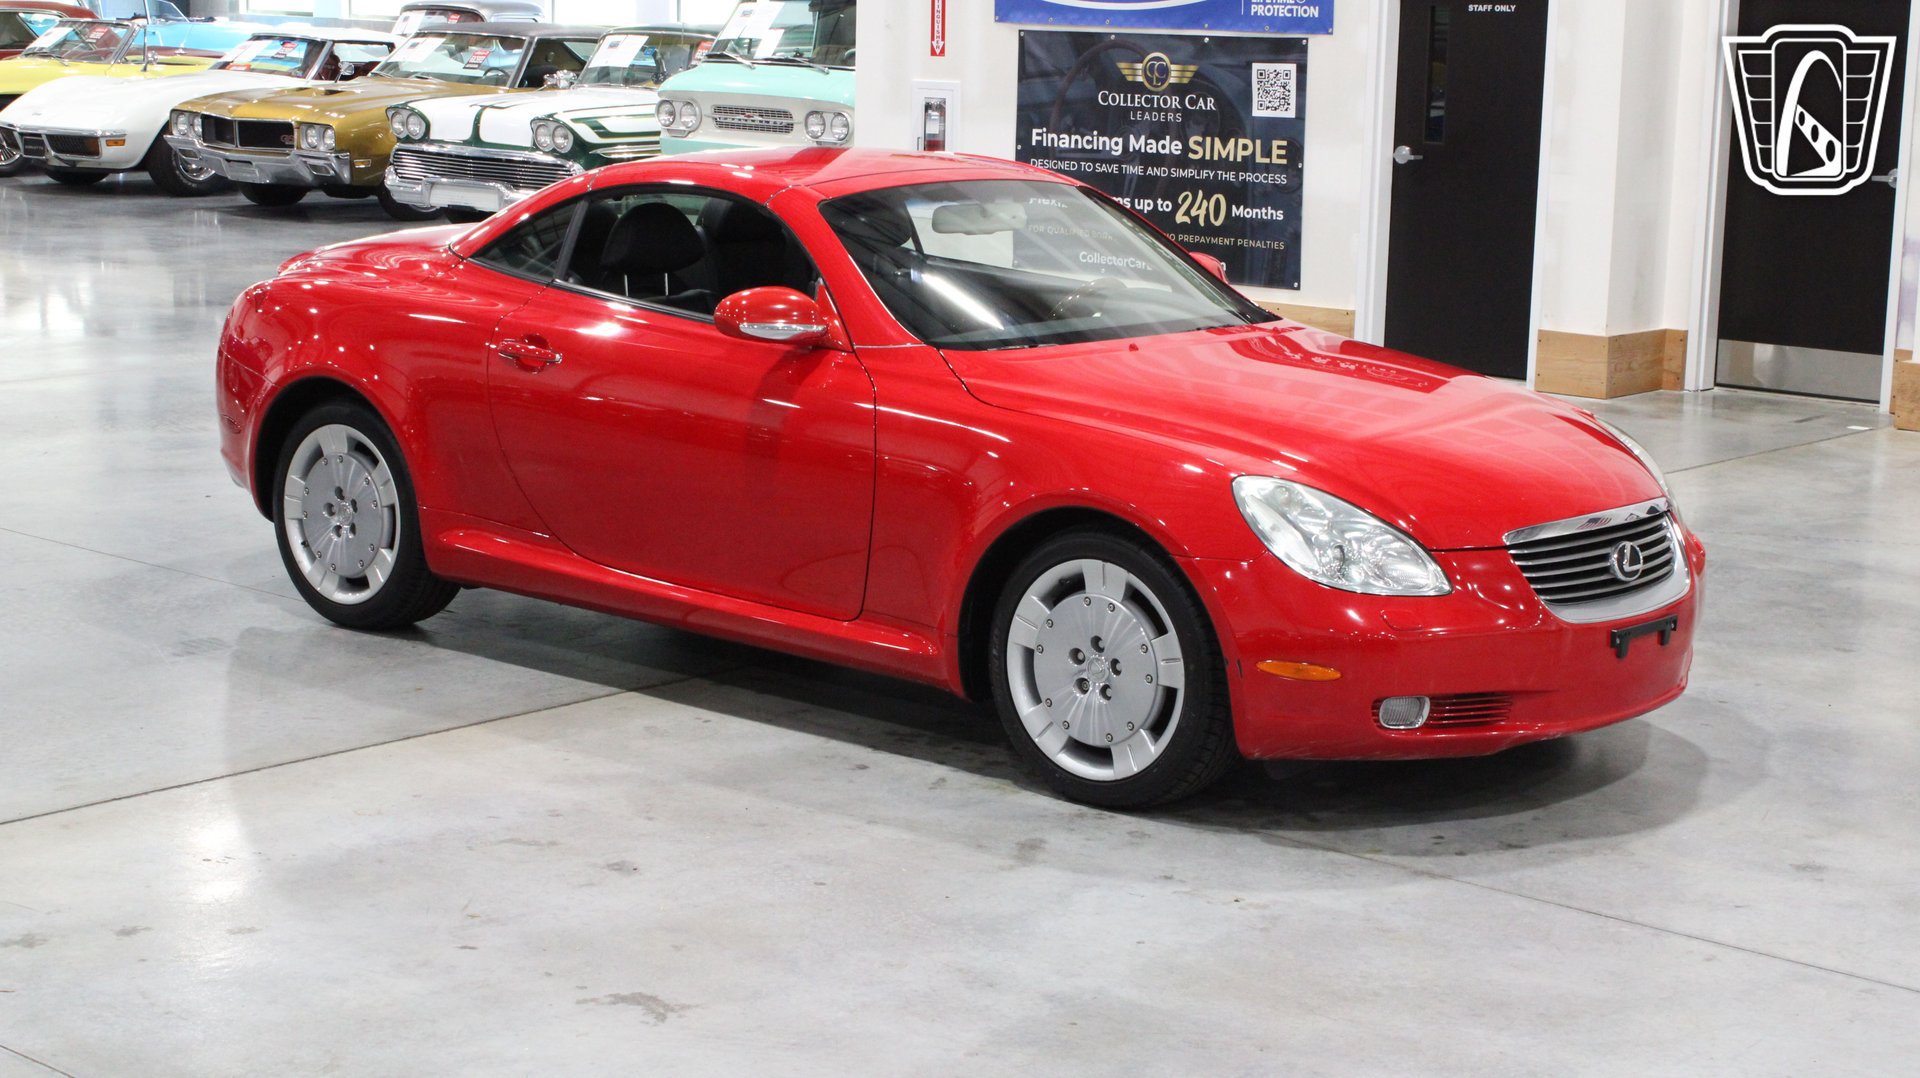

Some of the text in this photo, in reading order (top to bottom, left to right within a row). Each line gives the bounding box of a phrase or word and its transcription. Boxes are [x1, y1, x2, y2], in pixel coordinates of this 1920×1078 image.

[1251, 5, 1319, 17] PROTECTION
[1468, 4, 1516, 12] STAFF ONLY
[1130, 111, 1182, 122] LEADERS
[1031, 127, 1288, 164] Financing Made SIMPLE
[1030, 158, 1288, 184] DESIGNED TO SAVE TIME AND SIMPLIFY THE PROCESS
[1134, 198, 1154, 214] up
[1157, 197, 1173, 212] to
[1175, 189, 1227, 227] 240
[1231, 204, 1284, 221] Months
[1178, 234, 1235, 246] PREPAYMENT
[1237, 239, 1285, 250] PENALTIES
